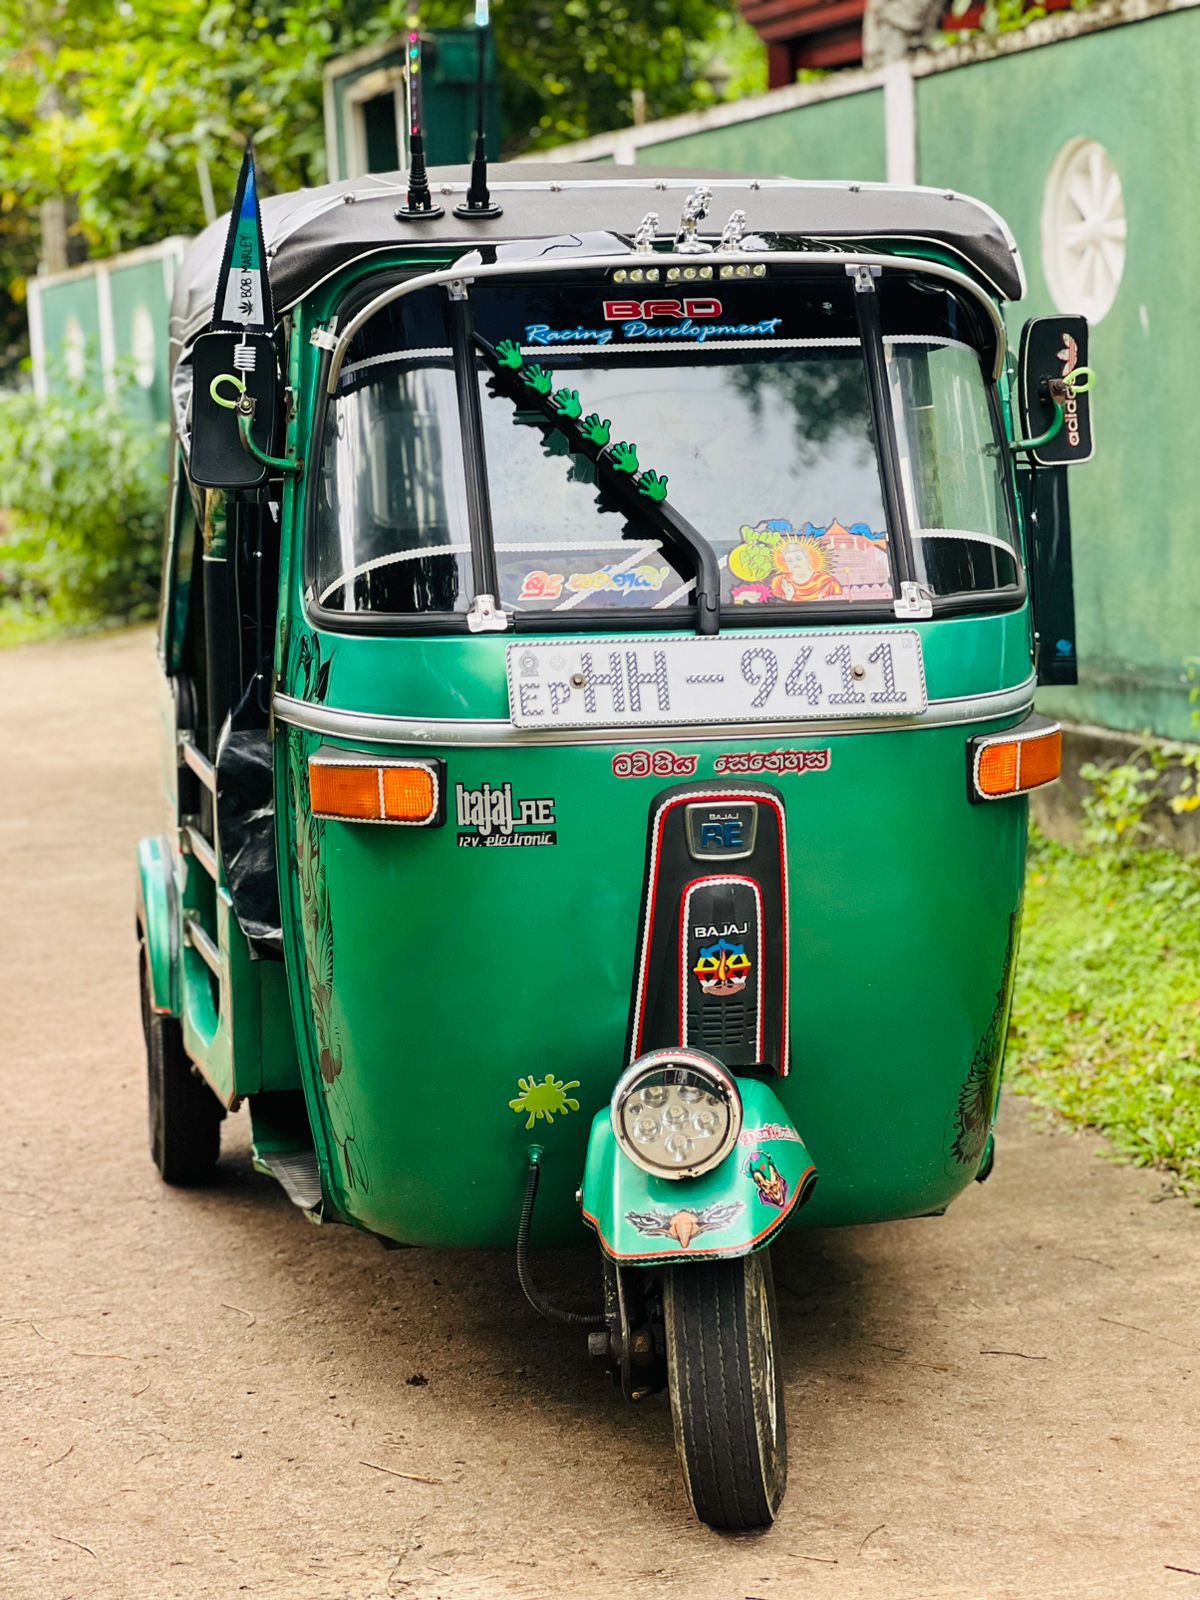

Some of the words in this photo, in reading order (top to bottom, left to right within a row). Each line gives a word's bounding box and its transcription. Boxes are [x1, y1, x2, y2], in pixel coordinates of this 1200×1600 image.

[239, 234, 252, 274] MARLEY
[239, 277, 252, 298] BOB
[603, 297, 723, 320] BRD
[524, 323, 614, 346] Racing
[620, 317, 783, 343] Development
[519, 682, 571, 716] EP
[708, 812, 740, 821] BAJAJ
[483, 832, 555, 848] electronic
[701, 821, 744, 849] RE
[693, 921, 750, 940] BAJAJ
